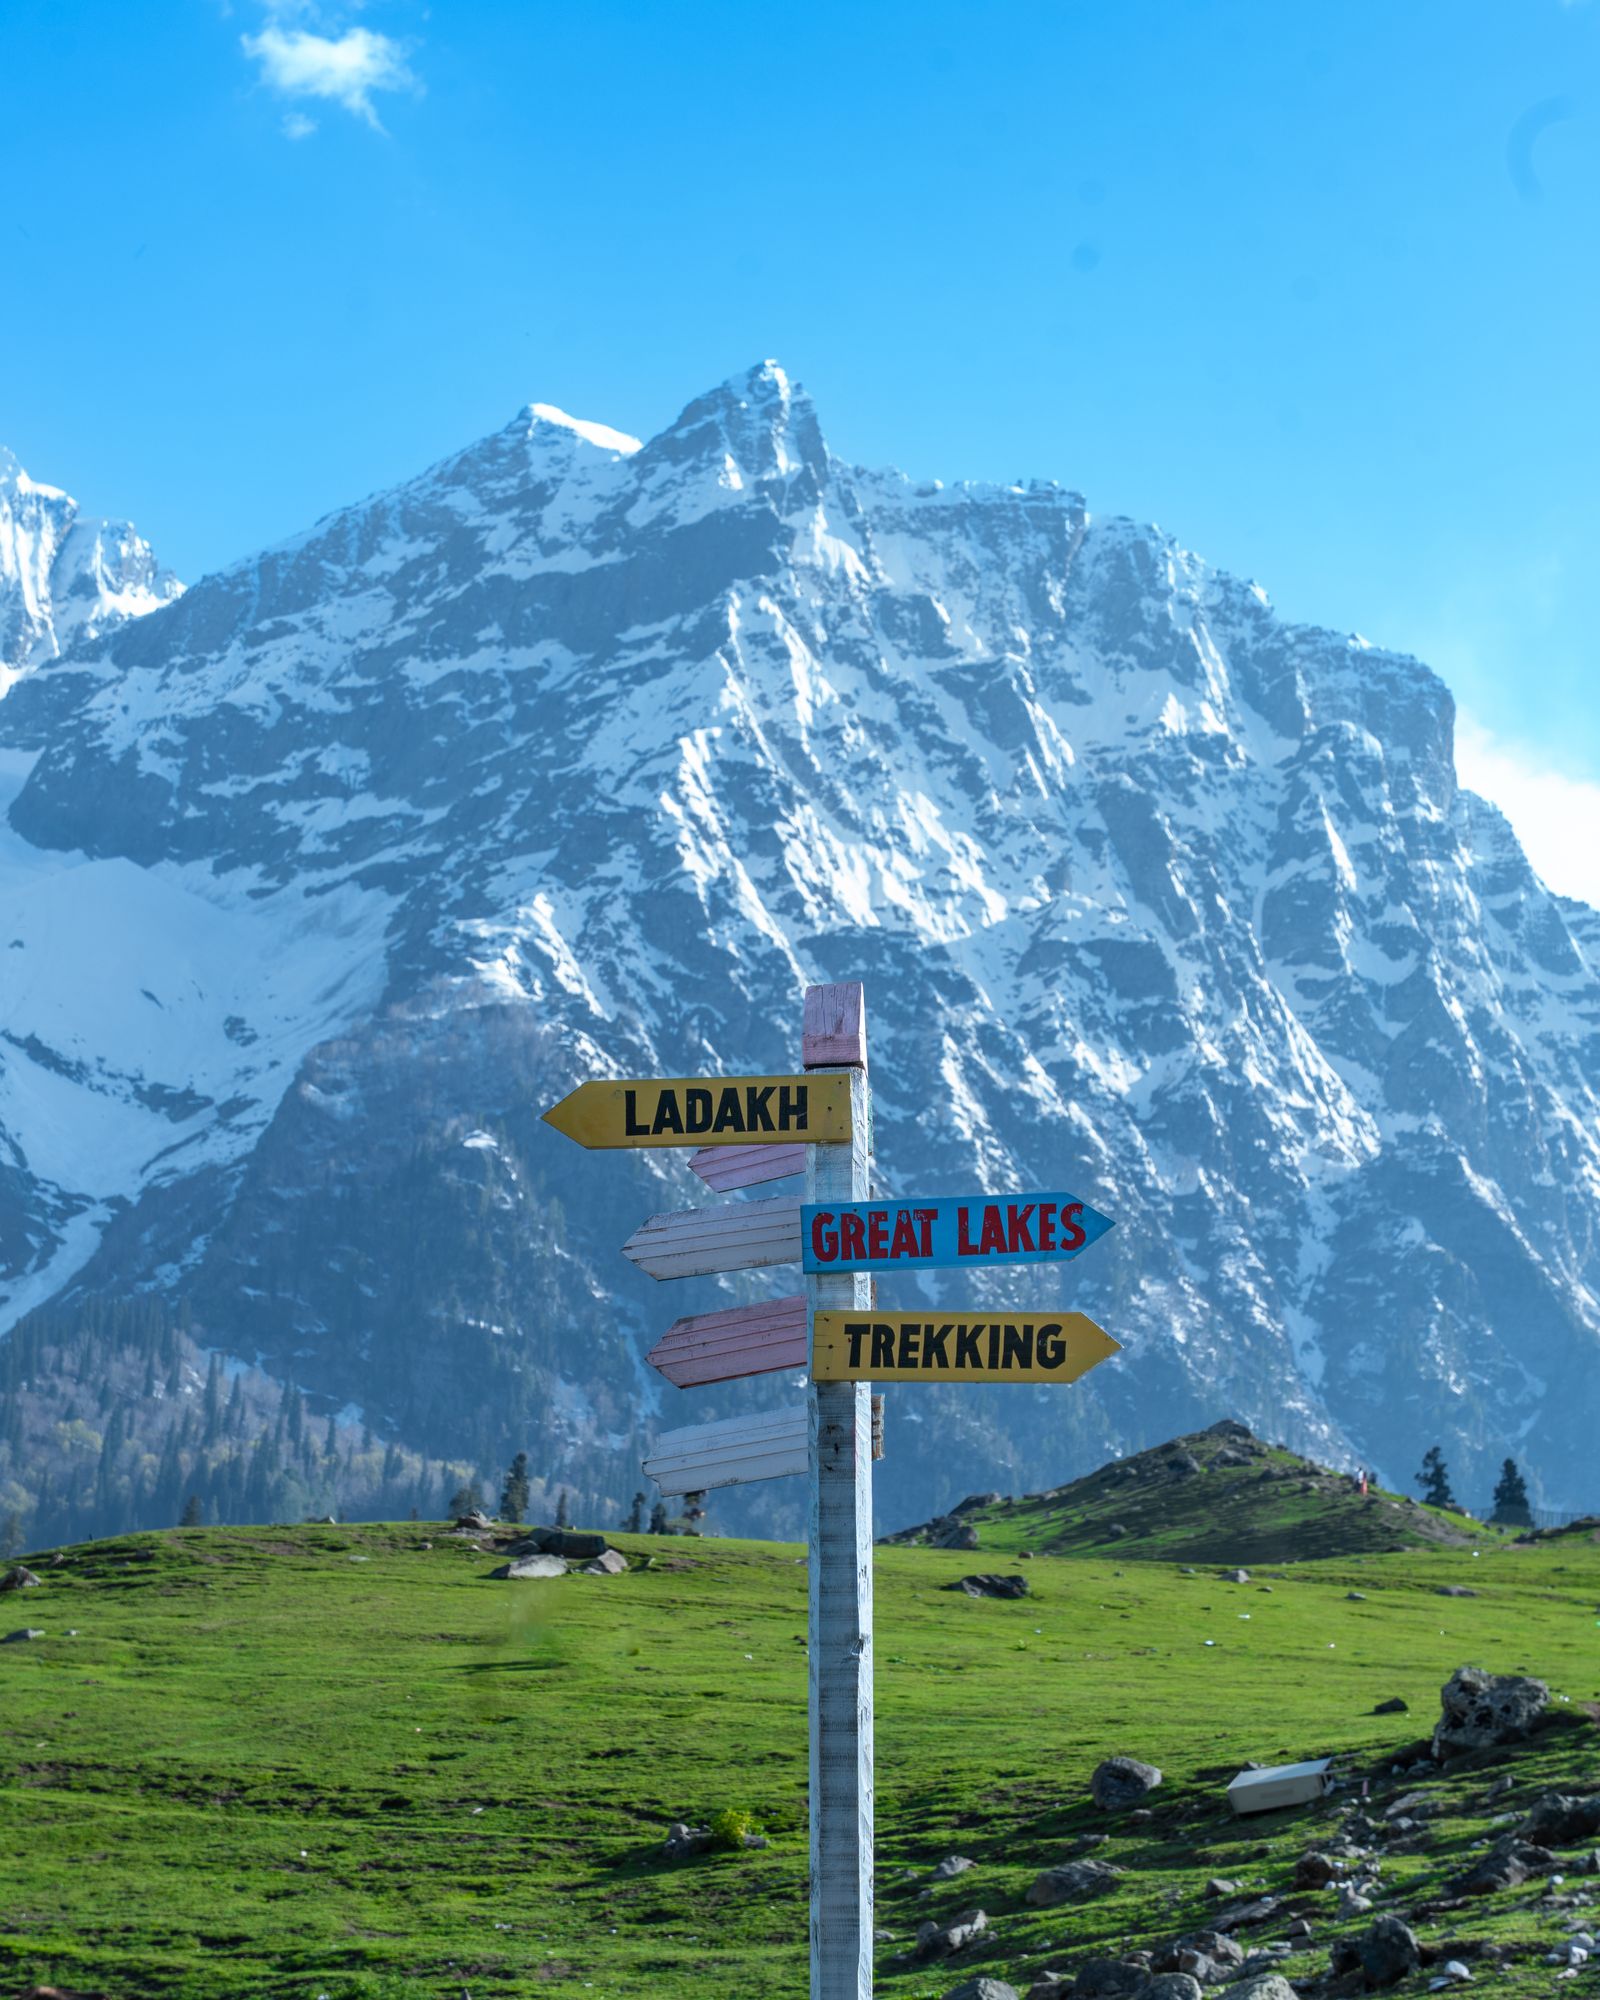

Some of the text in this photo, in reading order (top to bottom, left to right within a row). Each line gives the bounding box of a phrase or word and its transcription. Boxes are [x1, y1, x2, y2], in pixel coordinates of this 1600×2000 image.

[624, 1085, 808, 1136] LADAKH
[811, 1202, 1087, 1262] GREAT LAKES
[844, 1323, 1067, 1371] TREKKING
